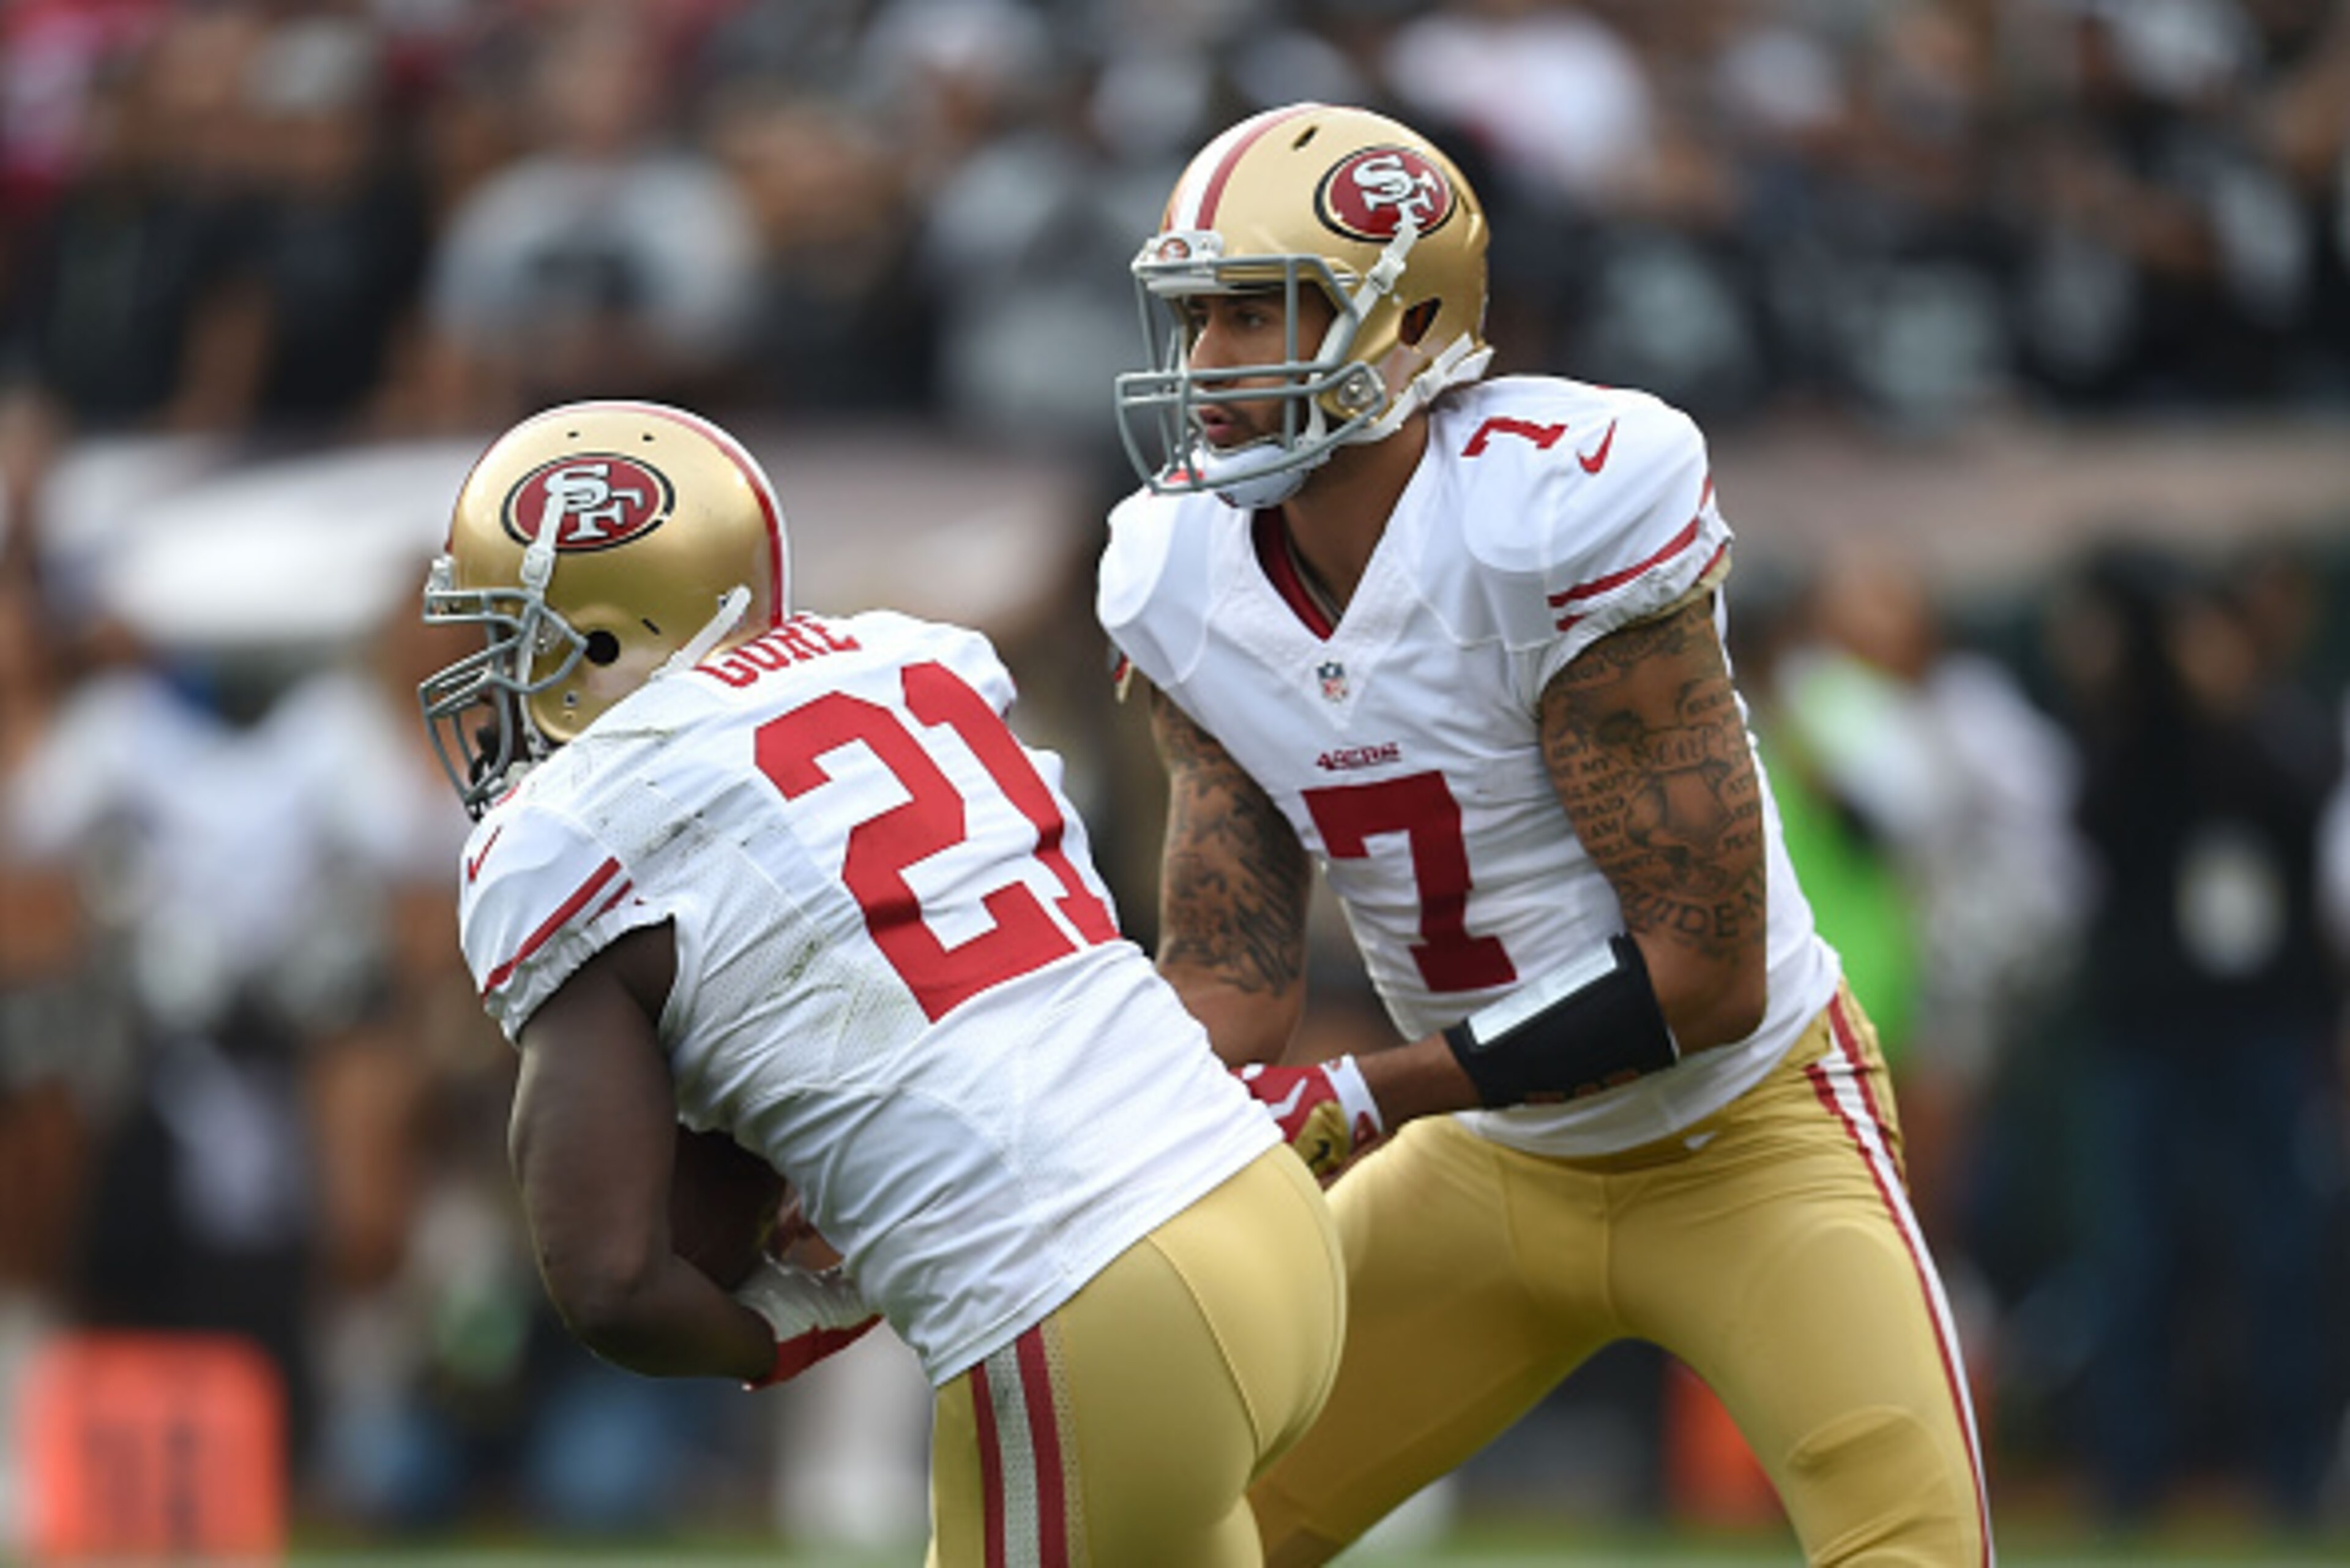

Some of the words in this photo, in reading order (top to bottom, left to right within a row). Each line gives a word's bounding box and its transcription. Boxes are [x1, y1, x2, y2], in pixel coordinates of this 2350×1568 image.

[1461, 417, 1567, 457] 7
[544, 463, 644, 540] SF
[690, 614, 861, 687] GORE
[753, 660, 1121, 1025] 21
[1300, 769, 1518, 993] 7
